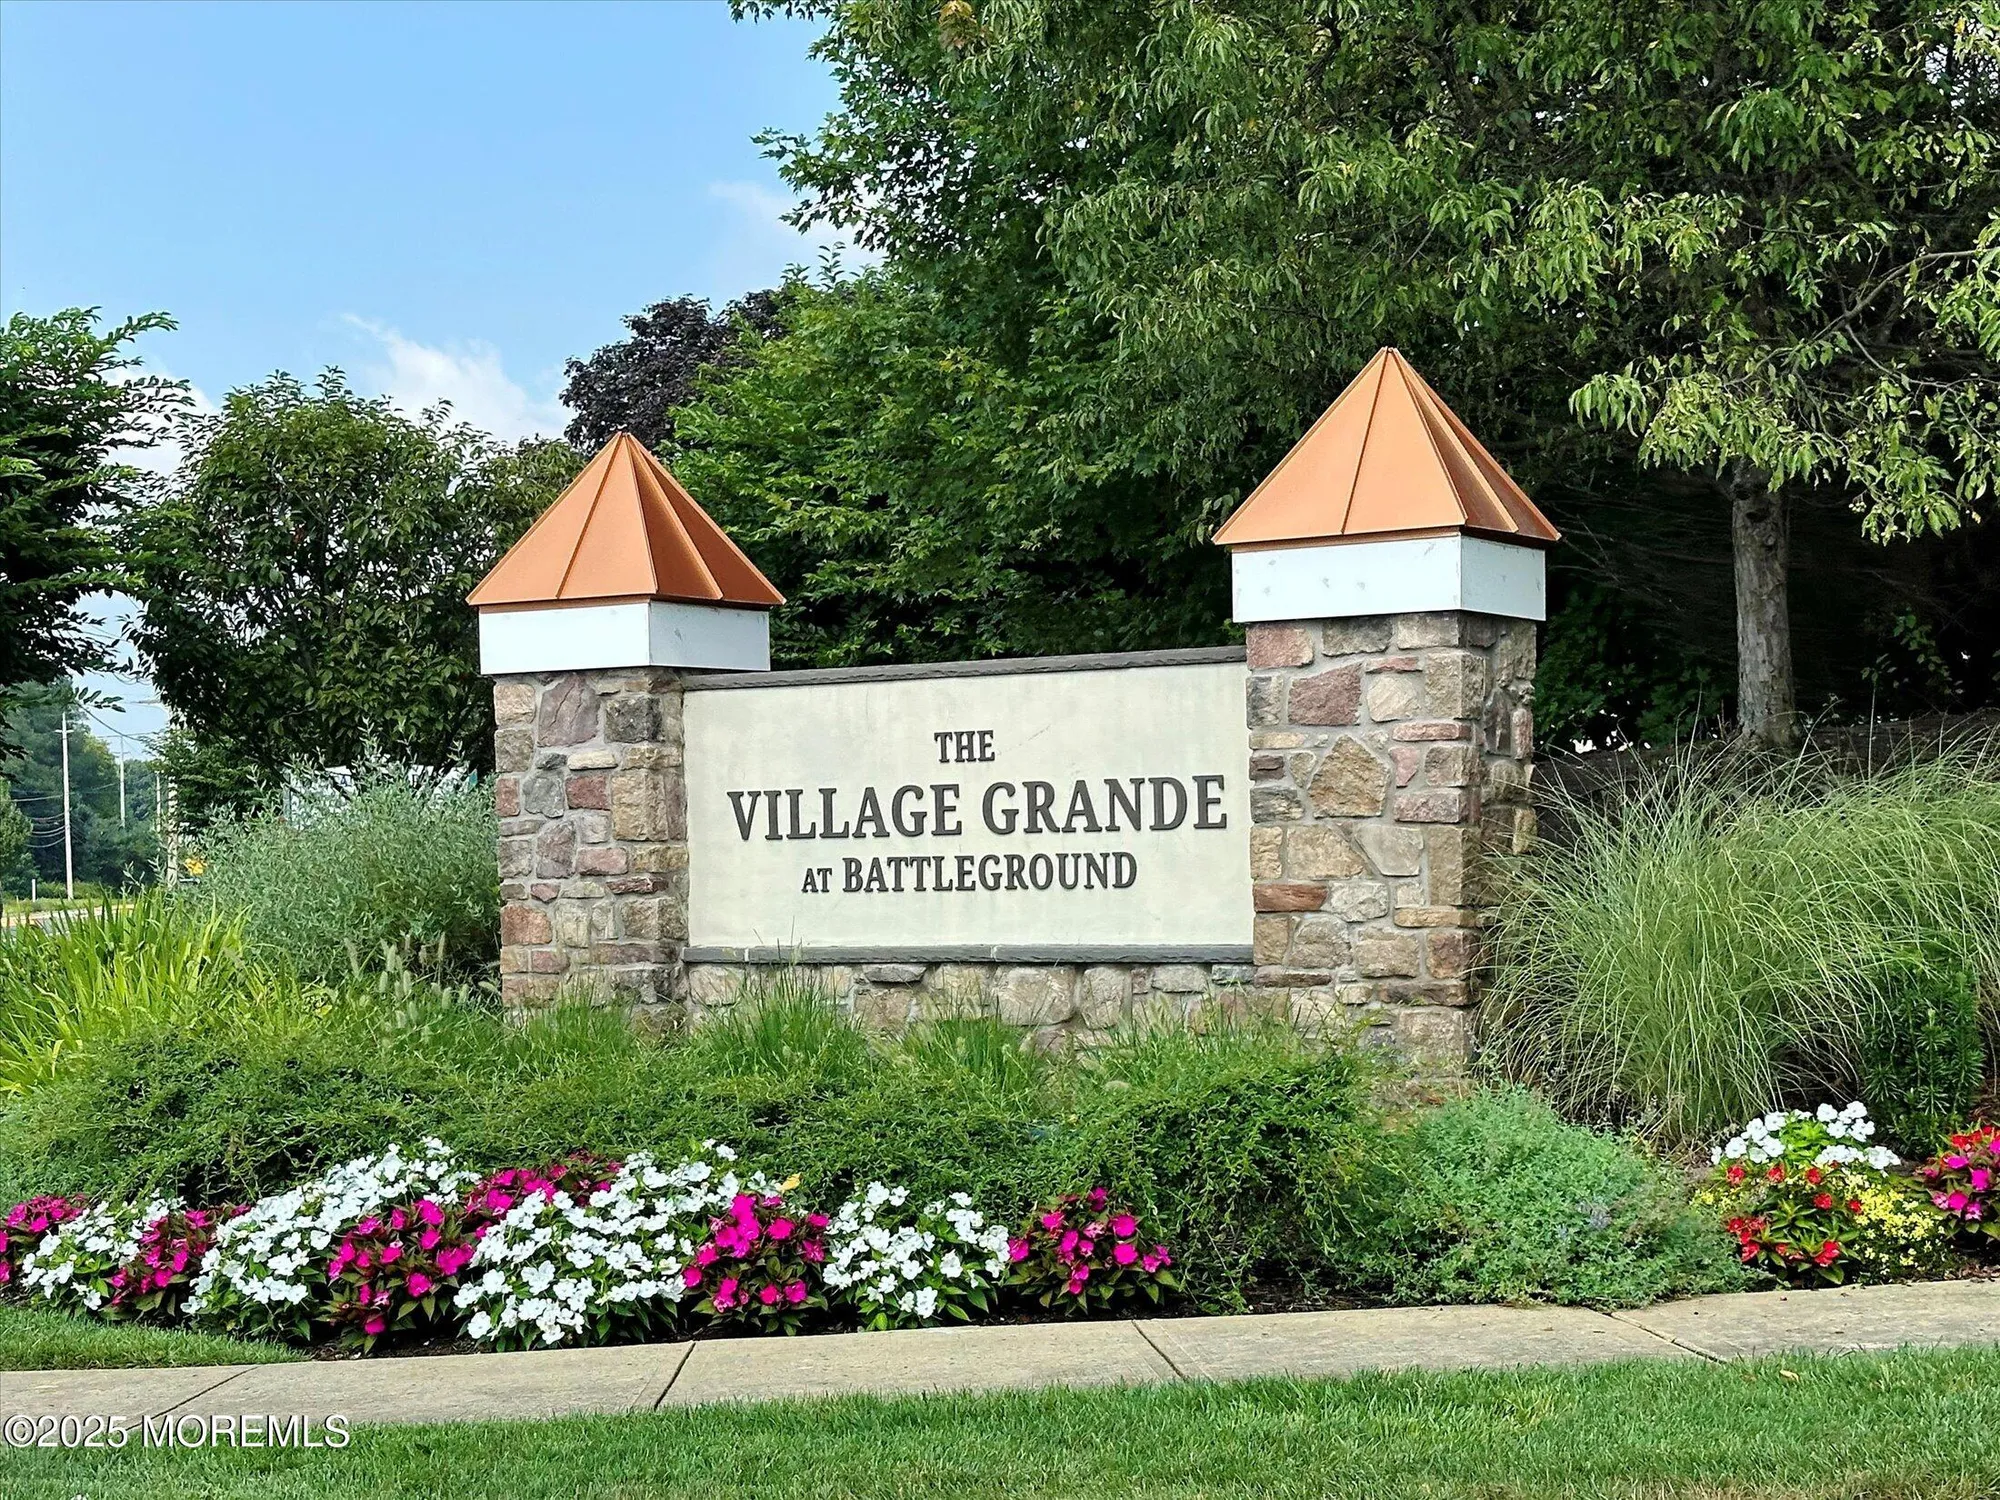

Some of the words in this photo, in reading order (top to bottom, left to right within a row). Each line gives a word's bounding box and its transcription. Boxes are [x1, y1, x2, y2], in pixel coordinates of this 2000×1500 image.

[933, 730, 996, 764] THE
[727, 784, 963, 842] VILLAGE
[982, 775, 1228, 836] GRANDE
[801, 867, 833, 894] AT
[841, 852, 1137, 894] BATTLEGROUND
